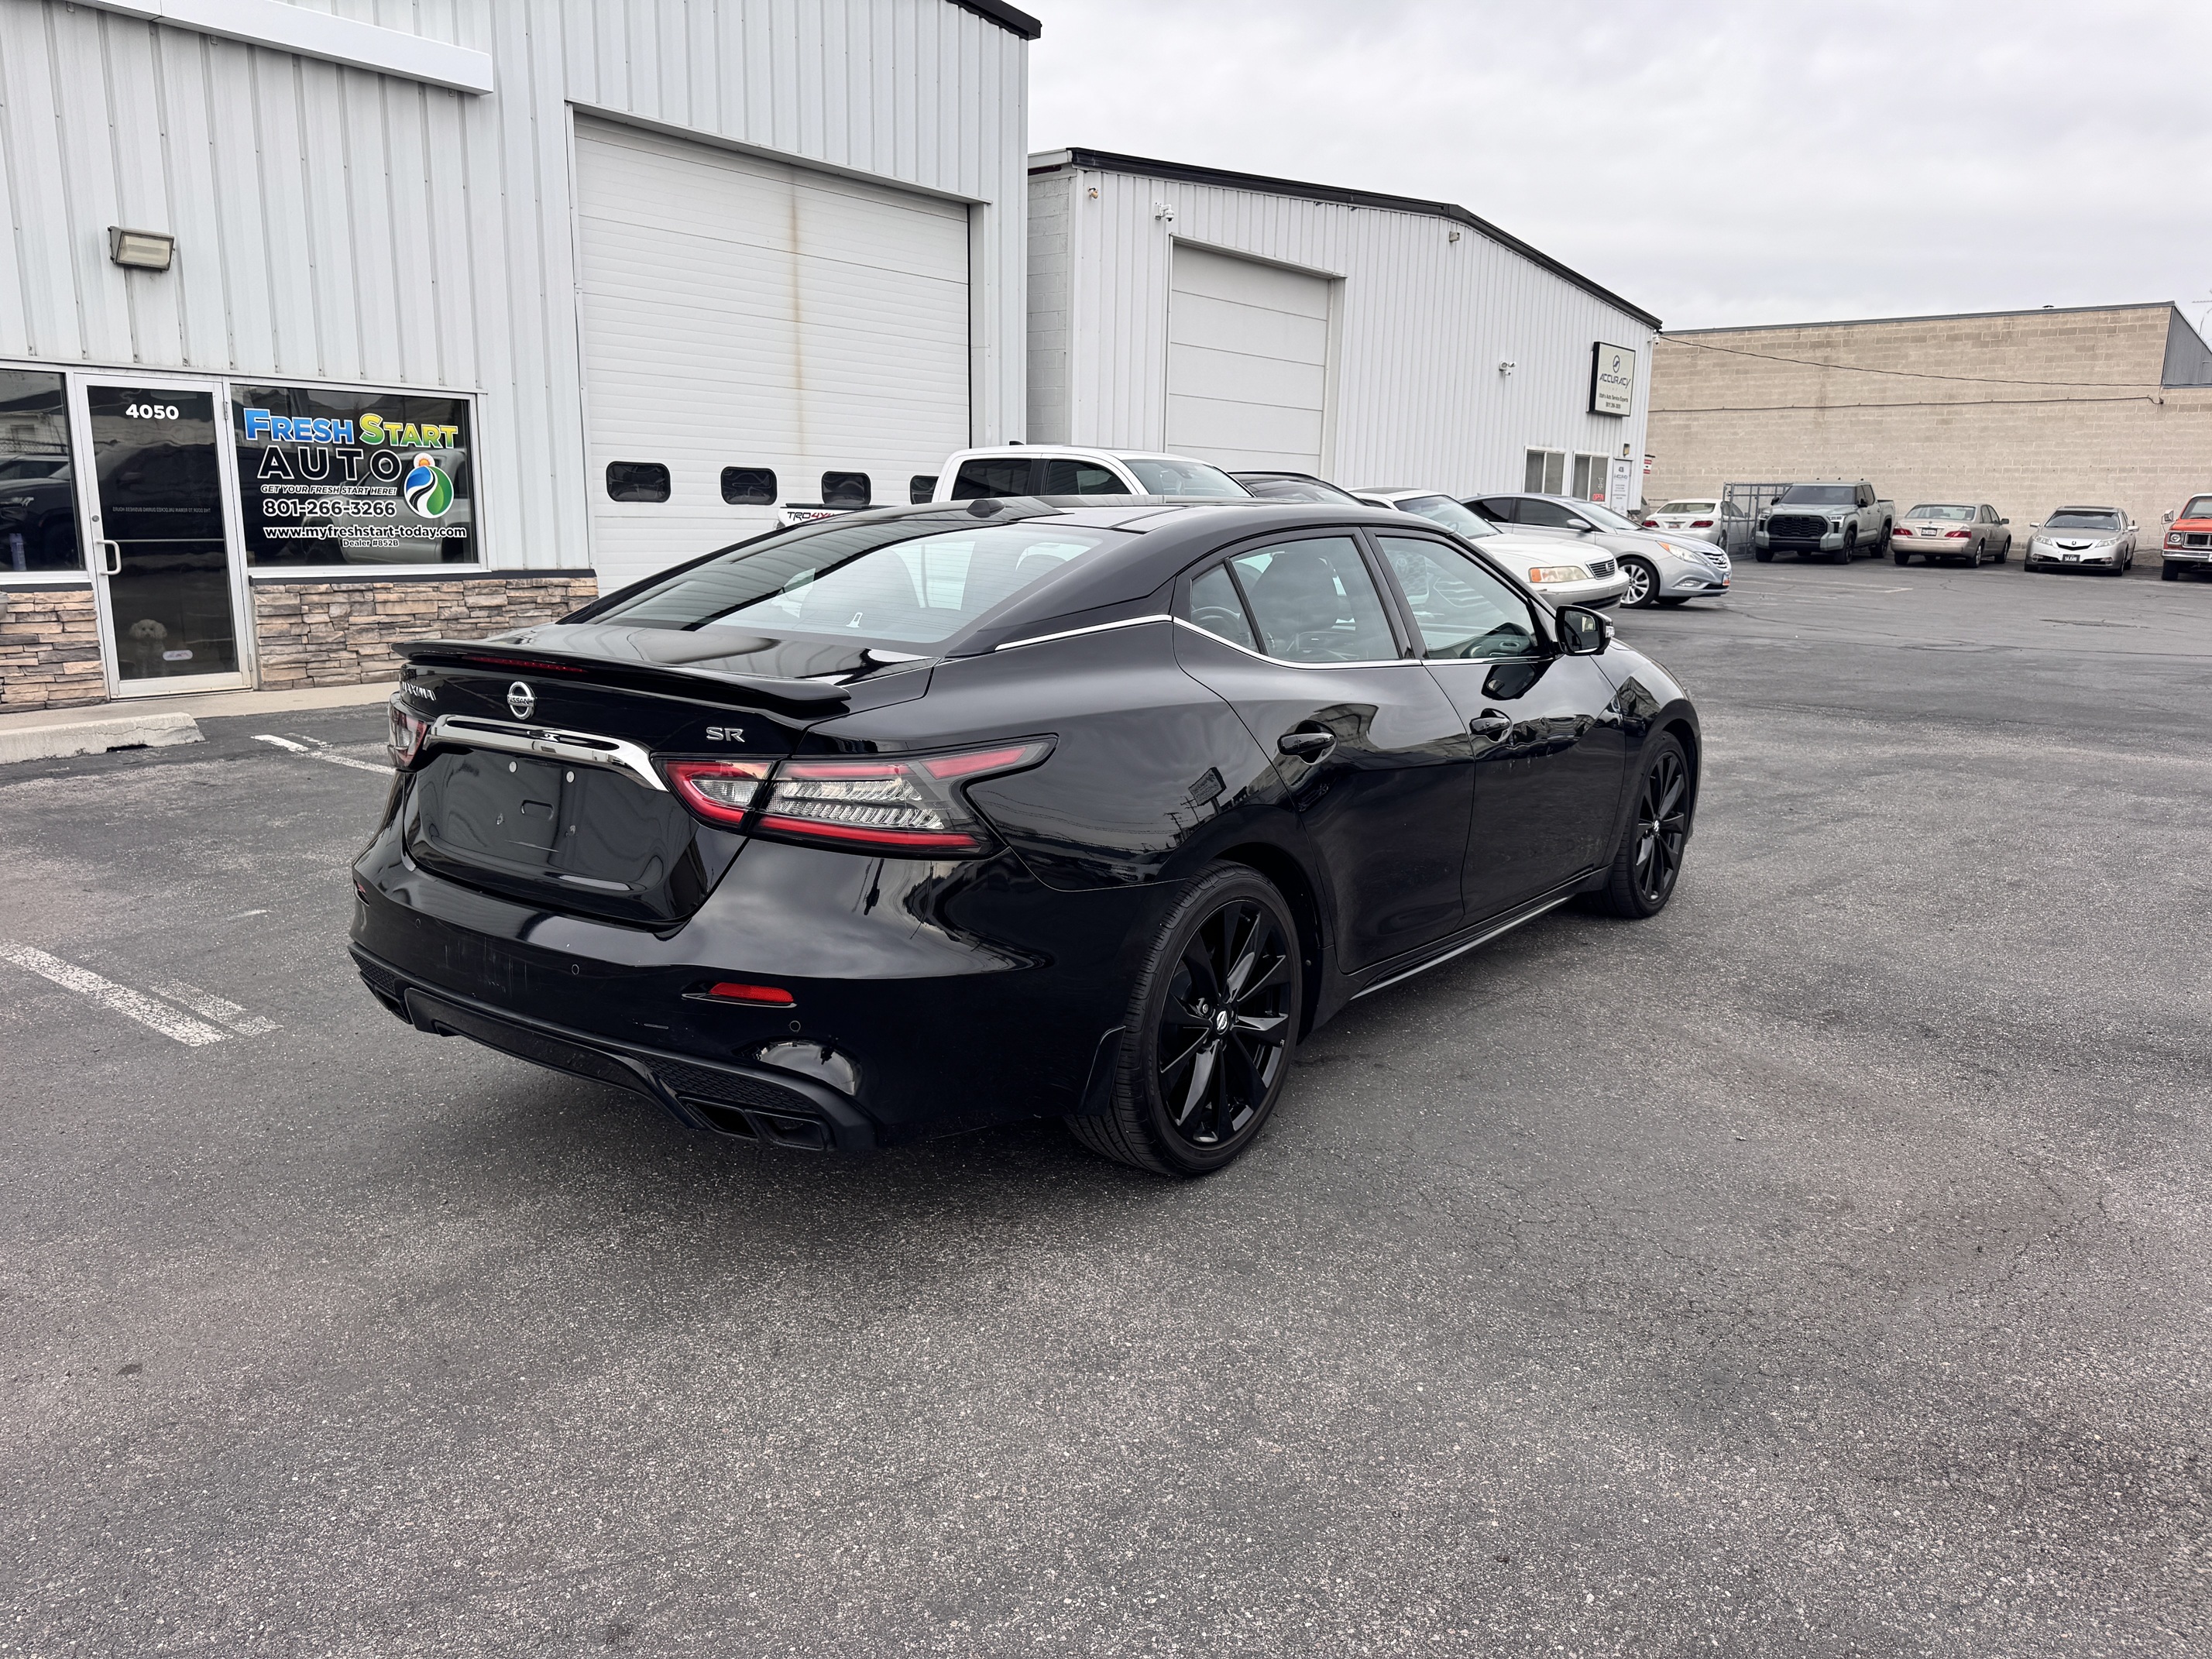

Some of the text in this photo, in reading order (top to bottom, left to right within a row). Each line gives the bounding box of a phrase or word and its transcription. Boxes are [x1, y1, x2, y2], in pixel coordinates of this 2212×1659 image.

[1599, 373, 1631, 389] ACCURACY
[125, 404, 179, 421] 4050
[257, 445, 402, 483] AUTO
[260, 484, 397, 496] GET YOUR FRESH START HERE!
[263, 498, 397, 517] 801-266-3266
[263, 524, 467, 540] www.myfreshstart-today.com
[342, 538, 370, 547] Dealer
[706, 726, 745, 743] SR
